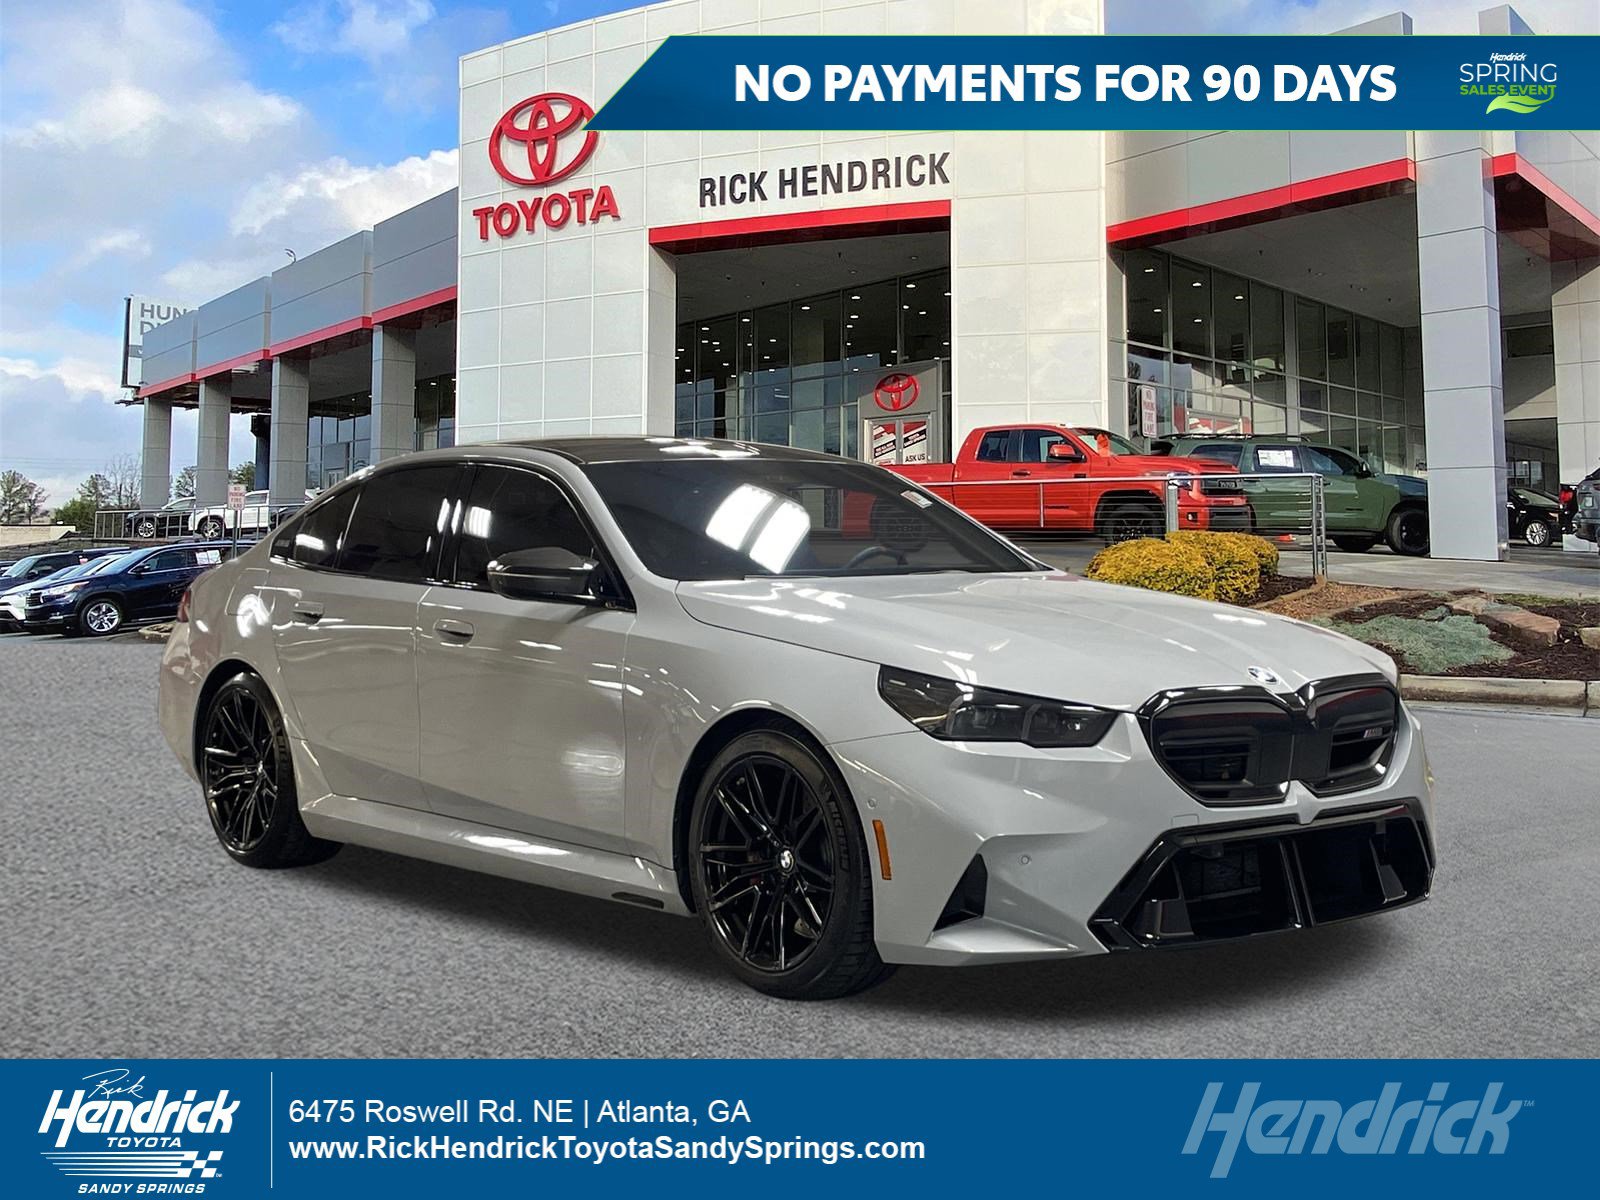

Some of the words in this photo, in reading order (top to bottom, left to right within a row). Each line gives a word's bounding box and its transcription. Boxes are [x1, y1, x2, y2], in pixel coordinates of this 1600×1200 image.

[699, 170, 769, 208] RICK
[778, 152, 952, 200] HENDRICK
[473, 185, 621, 241] TOYOTA
[905, 455, 917, 463] ASK
[918, 453, 926, 461] US
